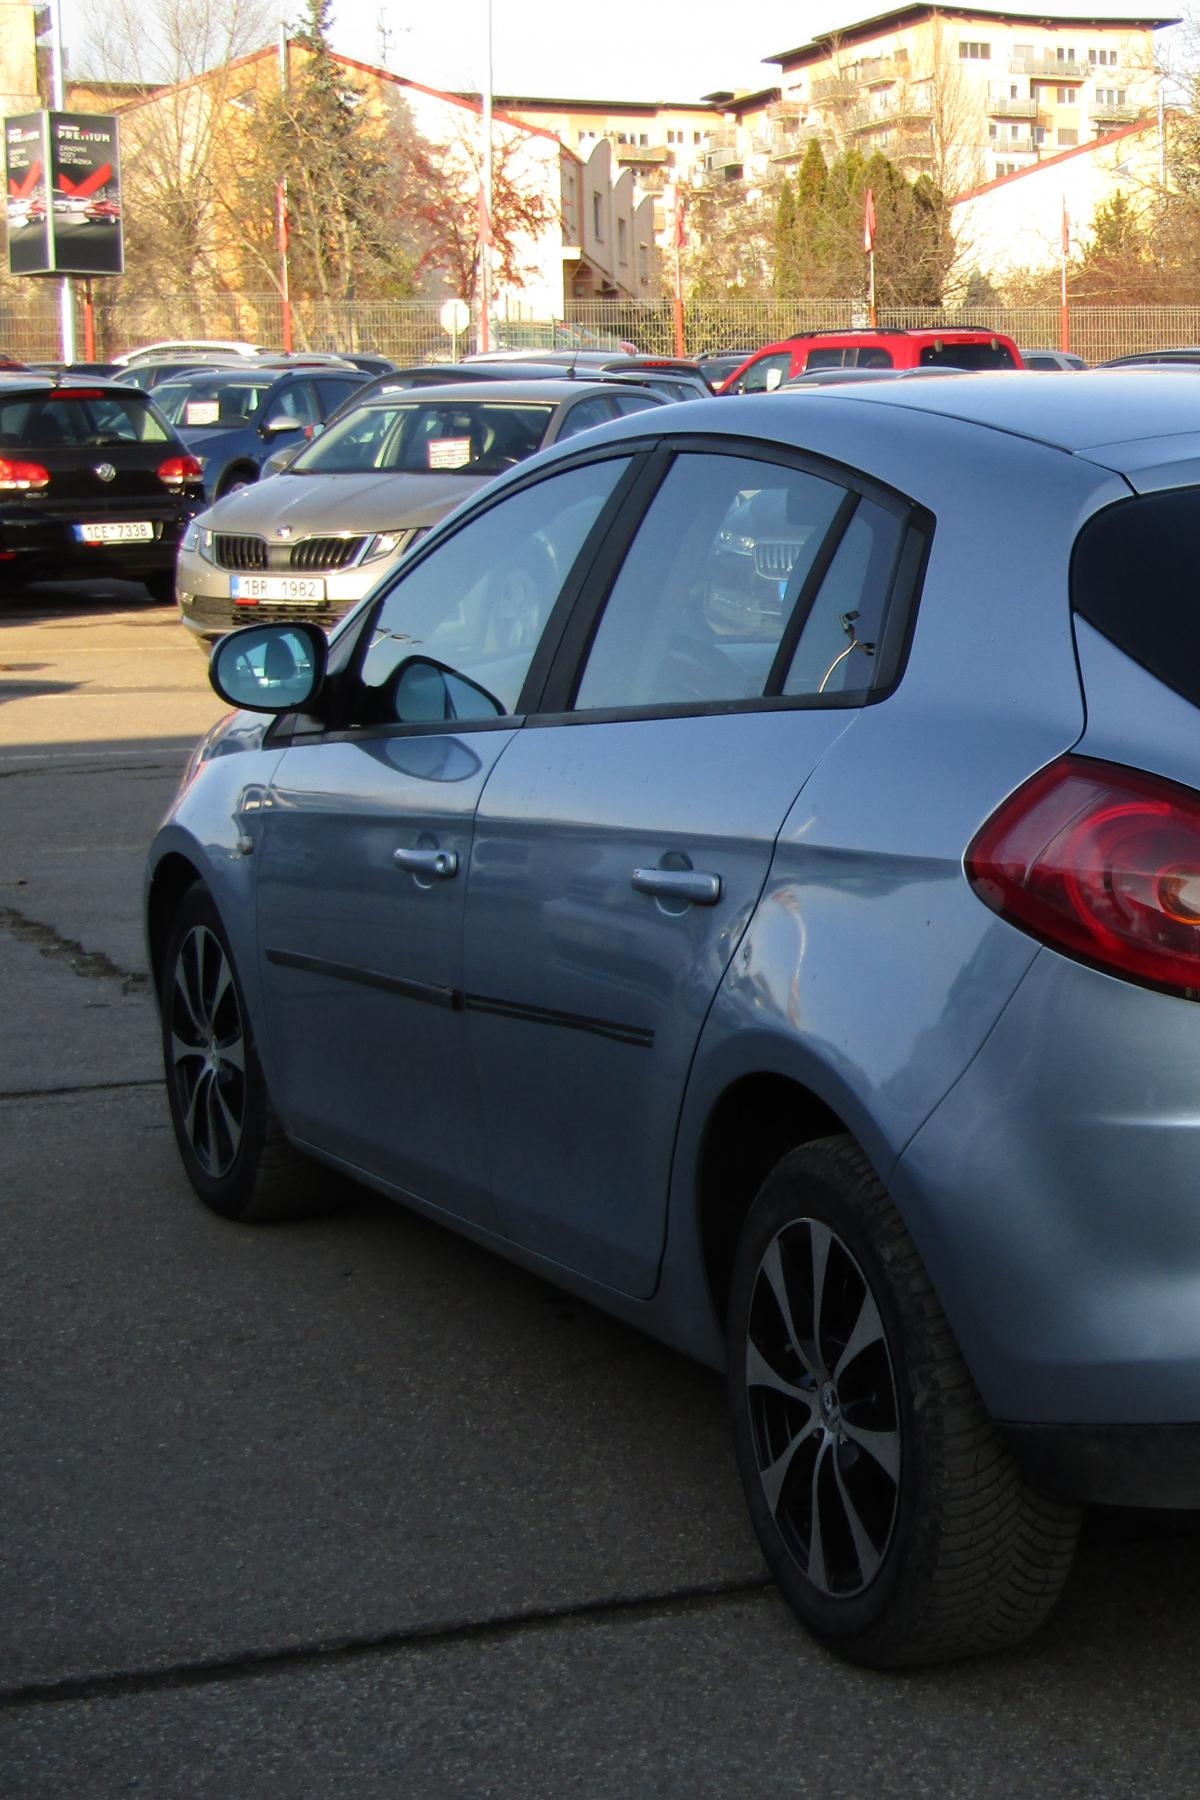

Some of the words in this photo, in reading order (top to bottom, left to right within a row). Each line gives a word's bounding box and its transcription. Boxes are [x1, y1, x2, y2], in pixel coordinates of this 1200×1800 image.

[58, 130, 111, 142] PREMIUM
[87, 526, 109, 539] 1CE
[117, 524, 148, 538] 7338
[244, 580, 268, 596] 1BR
[281, 581, 316, 597] 1982
